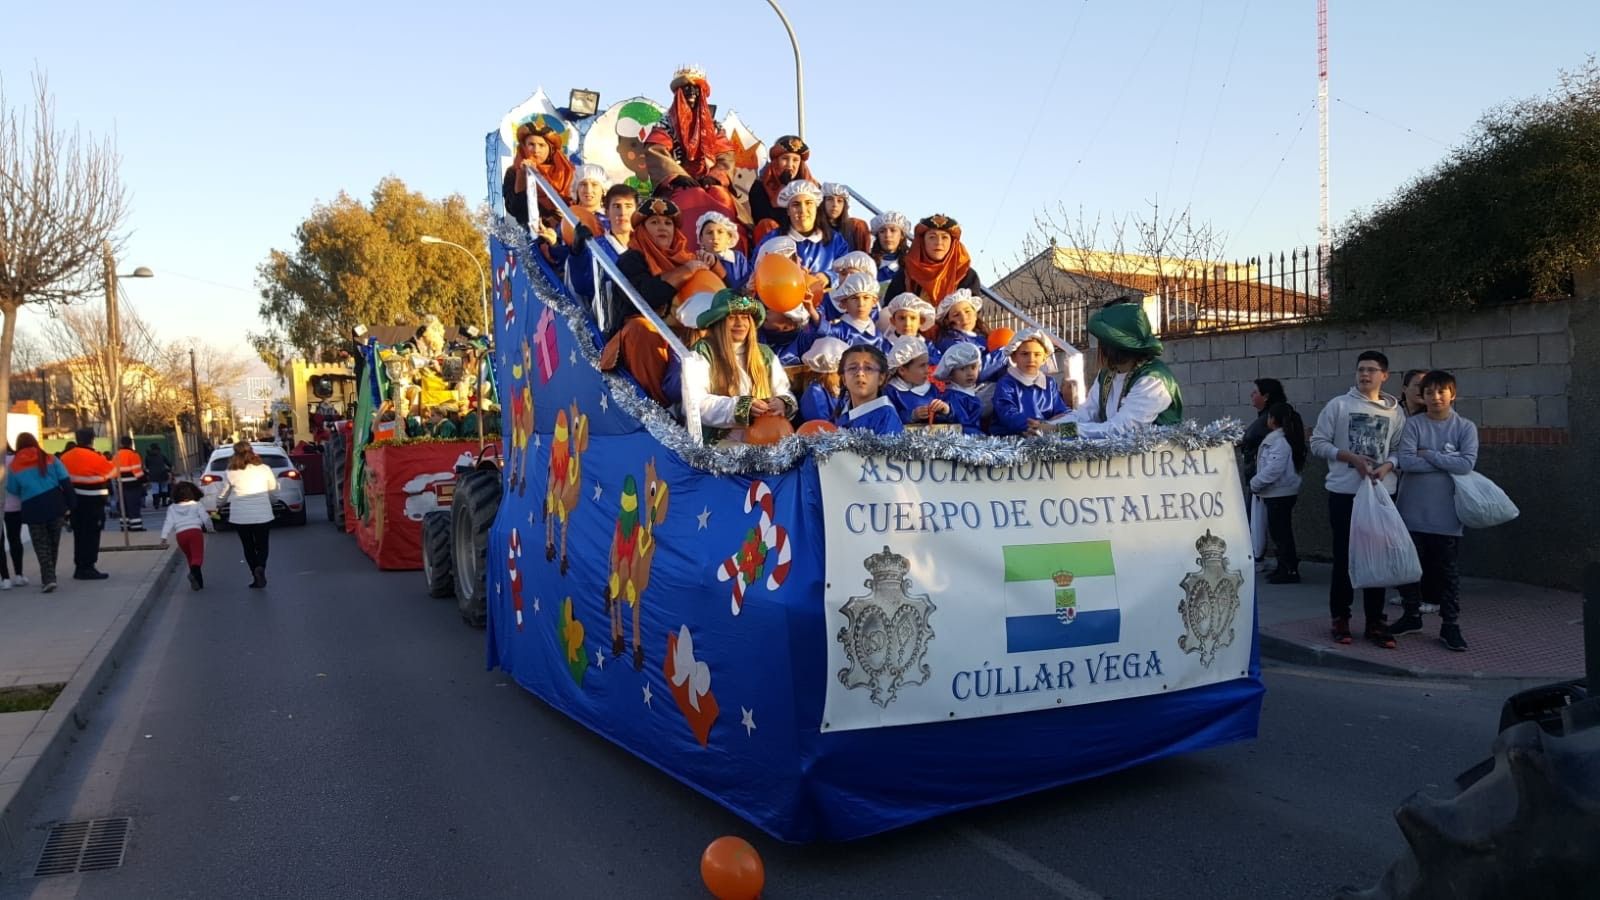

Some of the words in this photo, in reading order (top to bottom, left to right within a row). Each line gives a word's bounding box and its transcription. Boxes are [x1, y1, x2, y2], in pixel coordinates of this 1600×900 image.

[1066, 450, 1219, 479] CULTURAL
[845, 502, 980, 534] CUERPO
[990, 499, 1031, 529] DE
[1040, 491, 1224, 527] COSTALEROS
[952, 660, 1075, 700] CÚLLAR
[1085, 650, 1164, 684] VEGA
